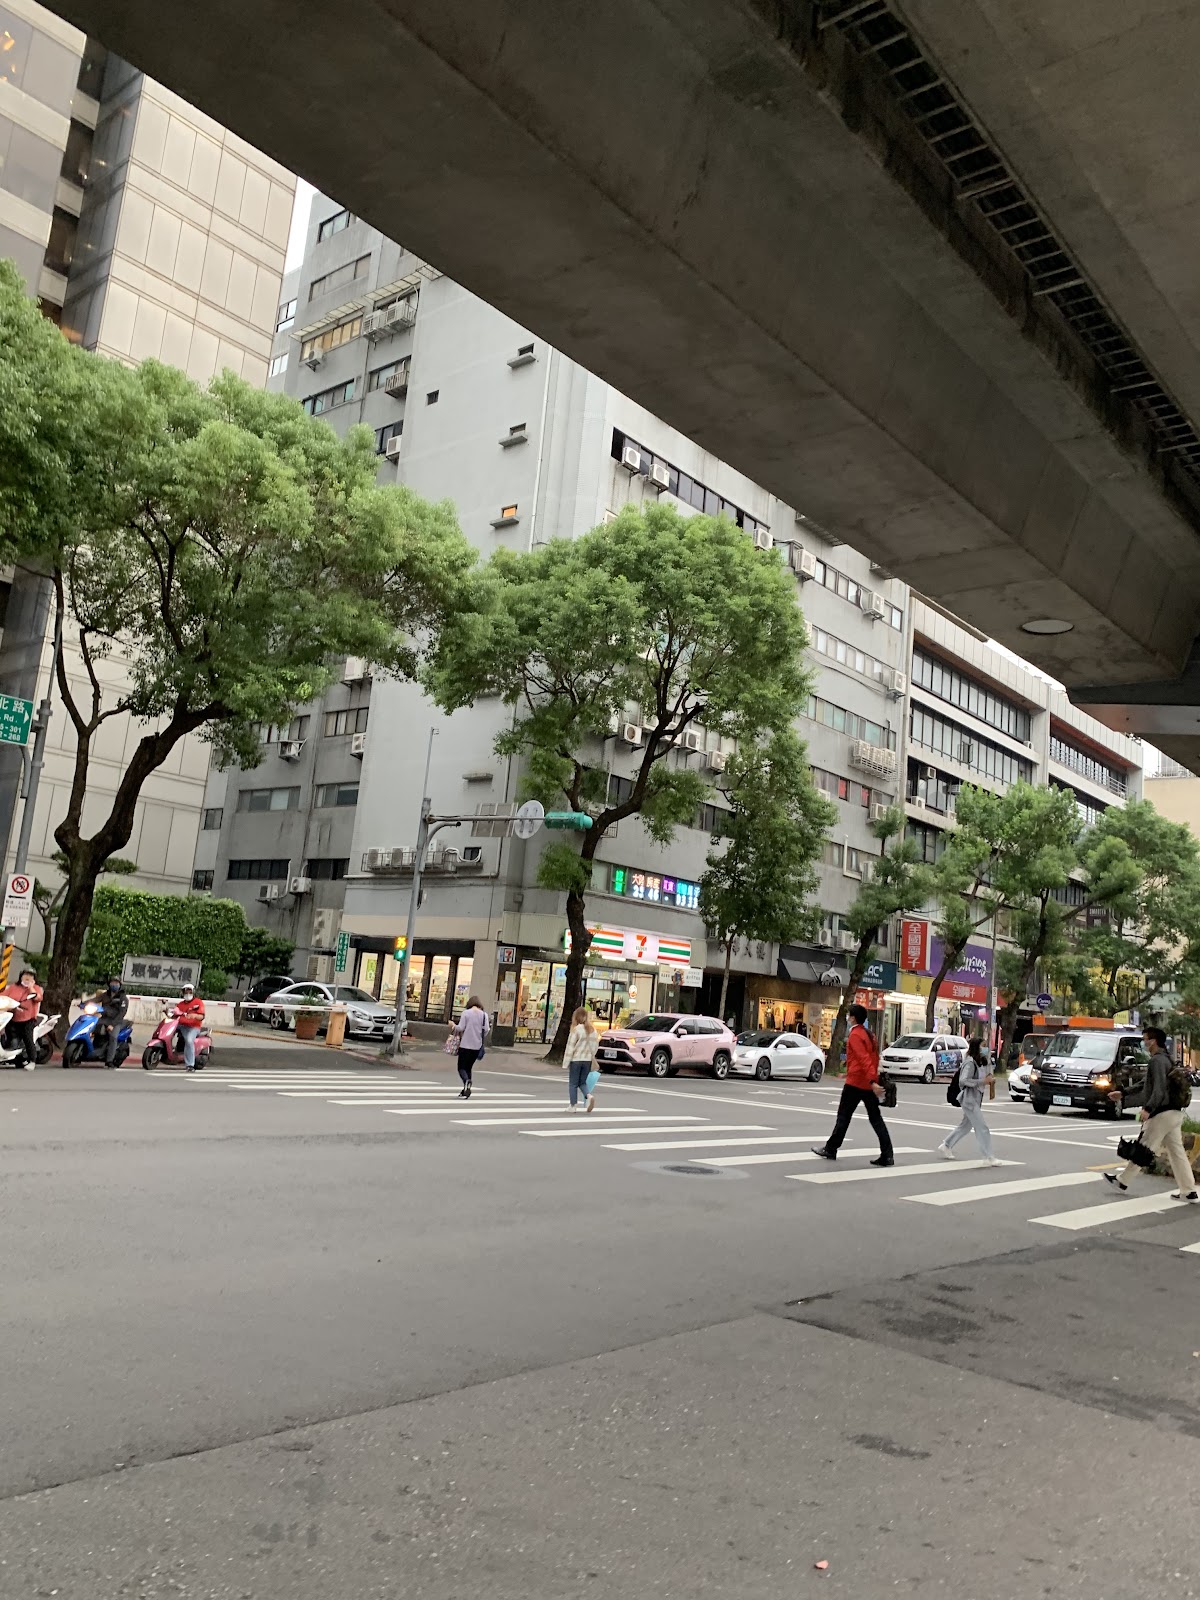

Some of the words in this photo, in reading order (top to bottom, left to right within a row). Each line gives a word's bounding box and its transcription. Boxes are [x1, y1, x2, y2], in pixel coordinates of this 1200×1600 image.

[908, 923, 922, 968] 全國電子
[952, 984, 975, 998] 全國電子
